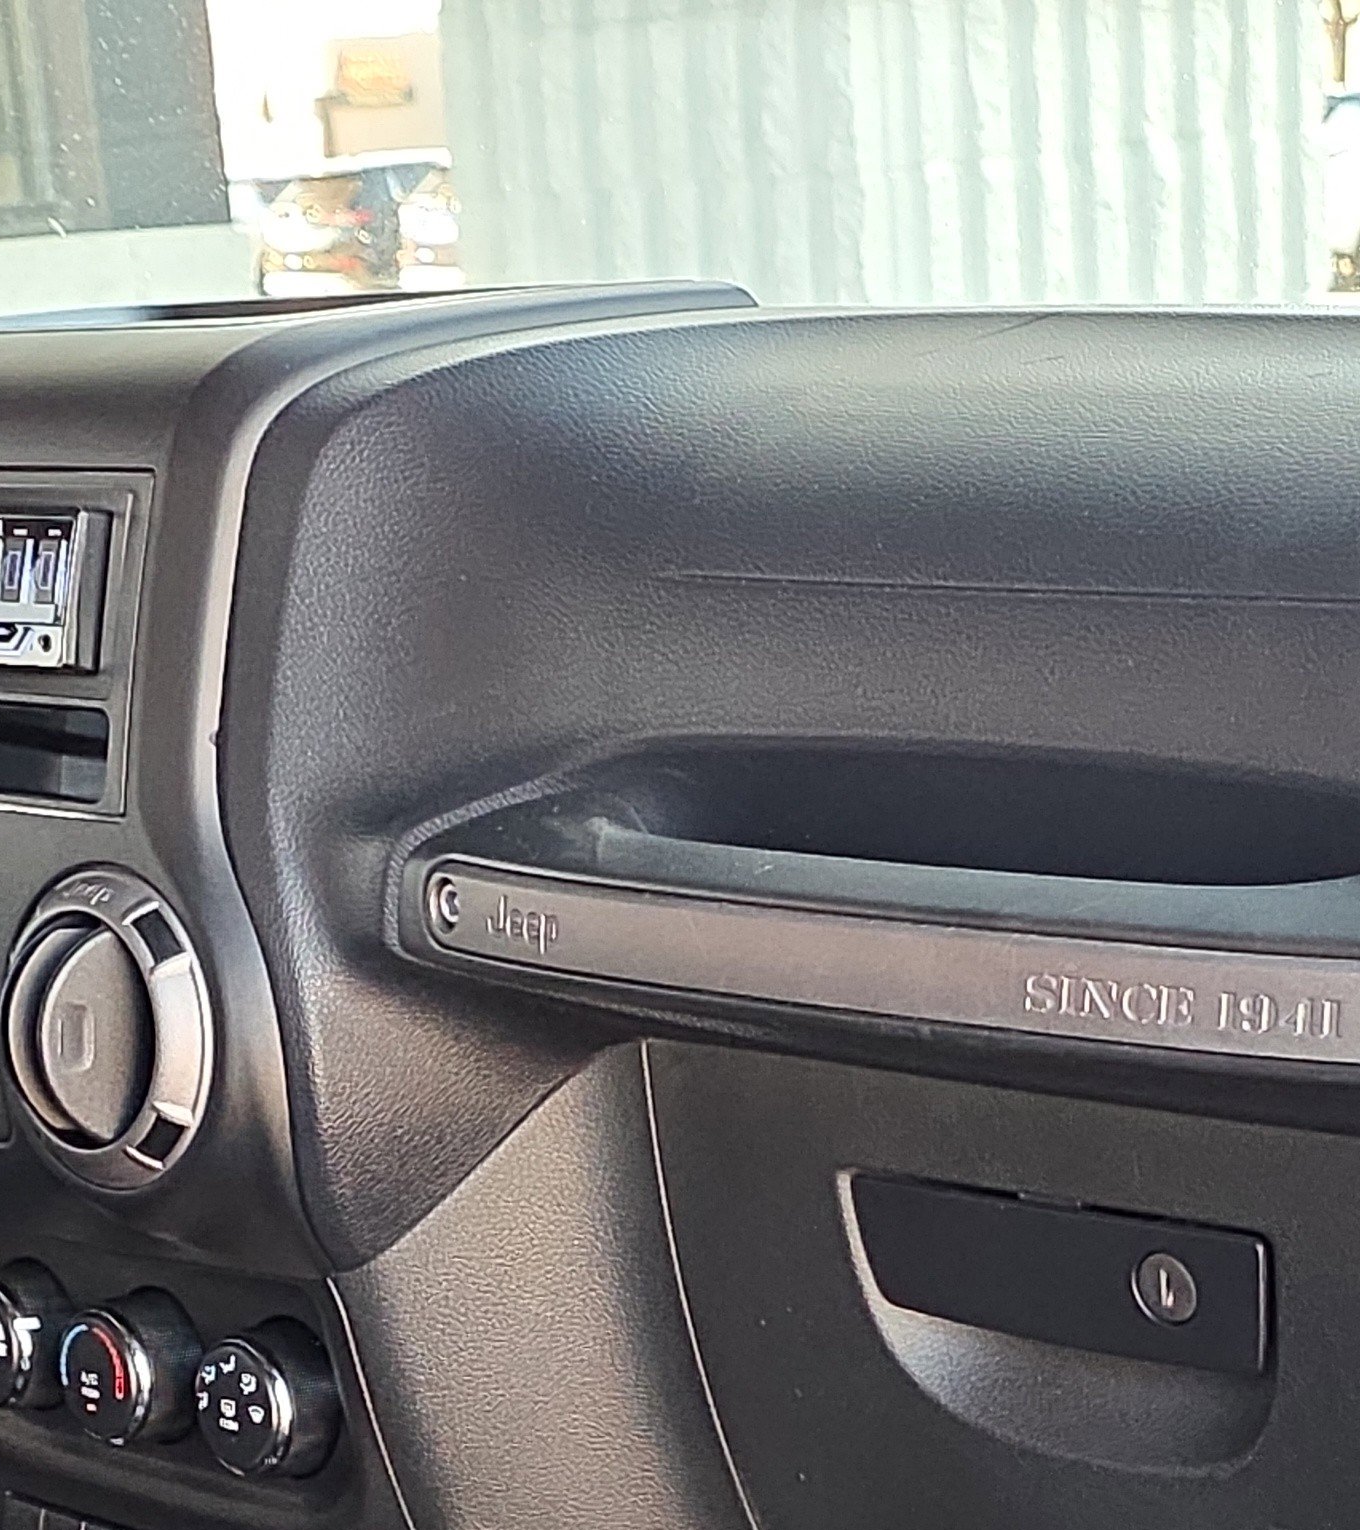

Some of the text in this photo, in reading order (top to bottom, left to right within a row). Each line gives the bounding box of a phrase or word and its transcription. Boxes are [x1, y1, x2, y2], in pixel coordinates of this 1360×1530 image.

[486, 895, 559, 954] Jeep
[1023, 973, 1343, 1038] SINCE 1941
